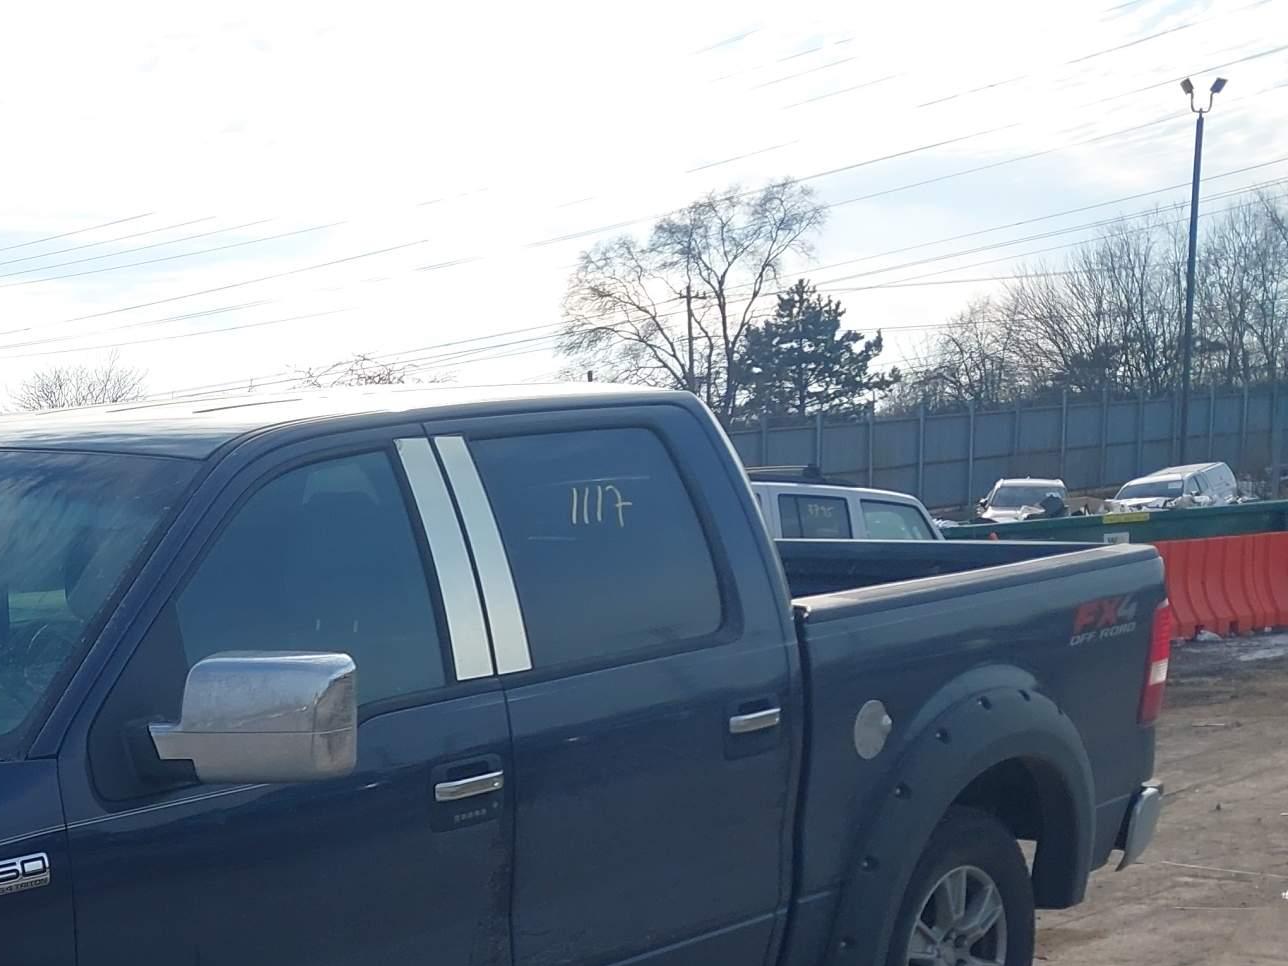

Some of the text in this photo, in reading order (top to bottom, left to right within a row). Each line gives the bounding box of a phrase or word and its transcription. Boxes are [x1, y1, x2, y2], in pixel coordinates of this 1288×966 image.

[572, 485, 633, 528] 1117
[1069, 621, 1137, 647] OFF ROAD
[1073, 594, 1138, 634] FX4
